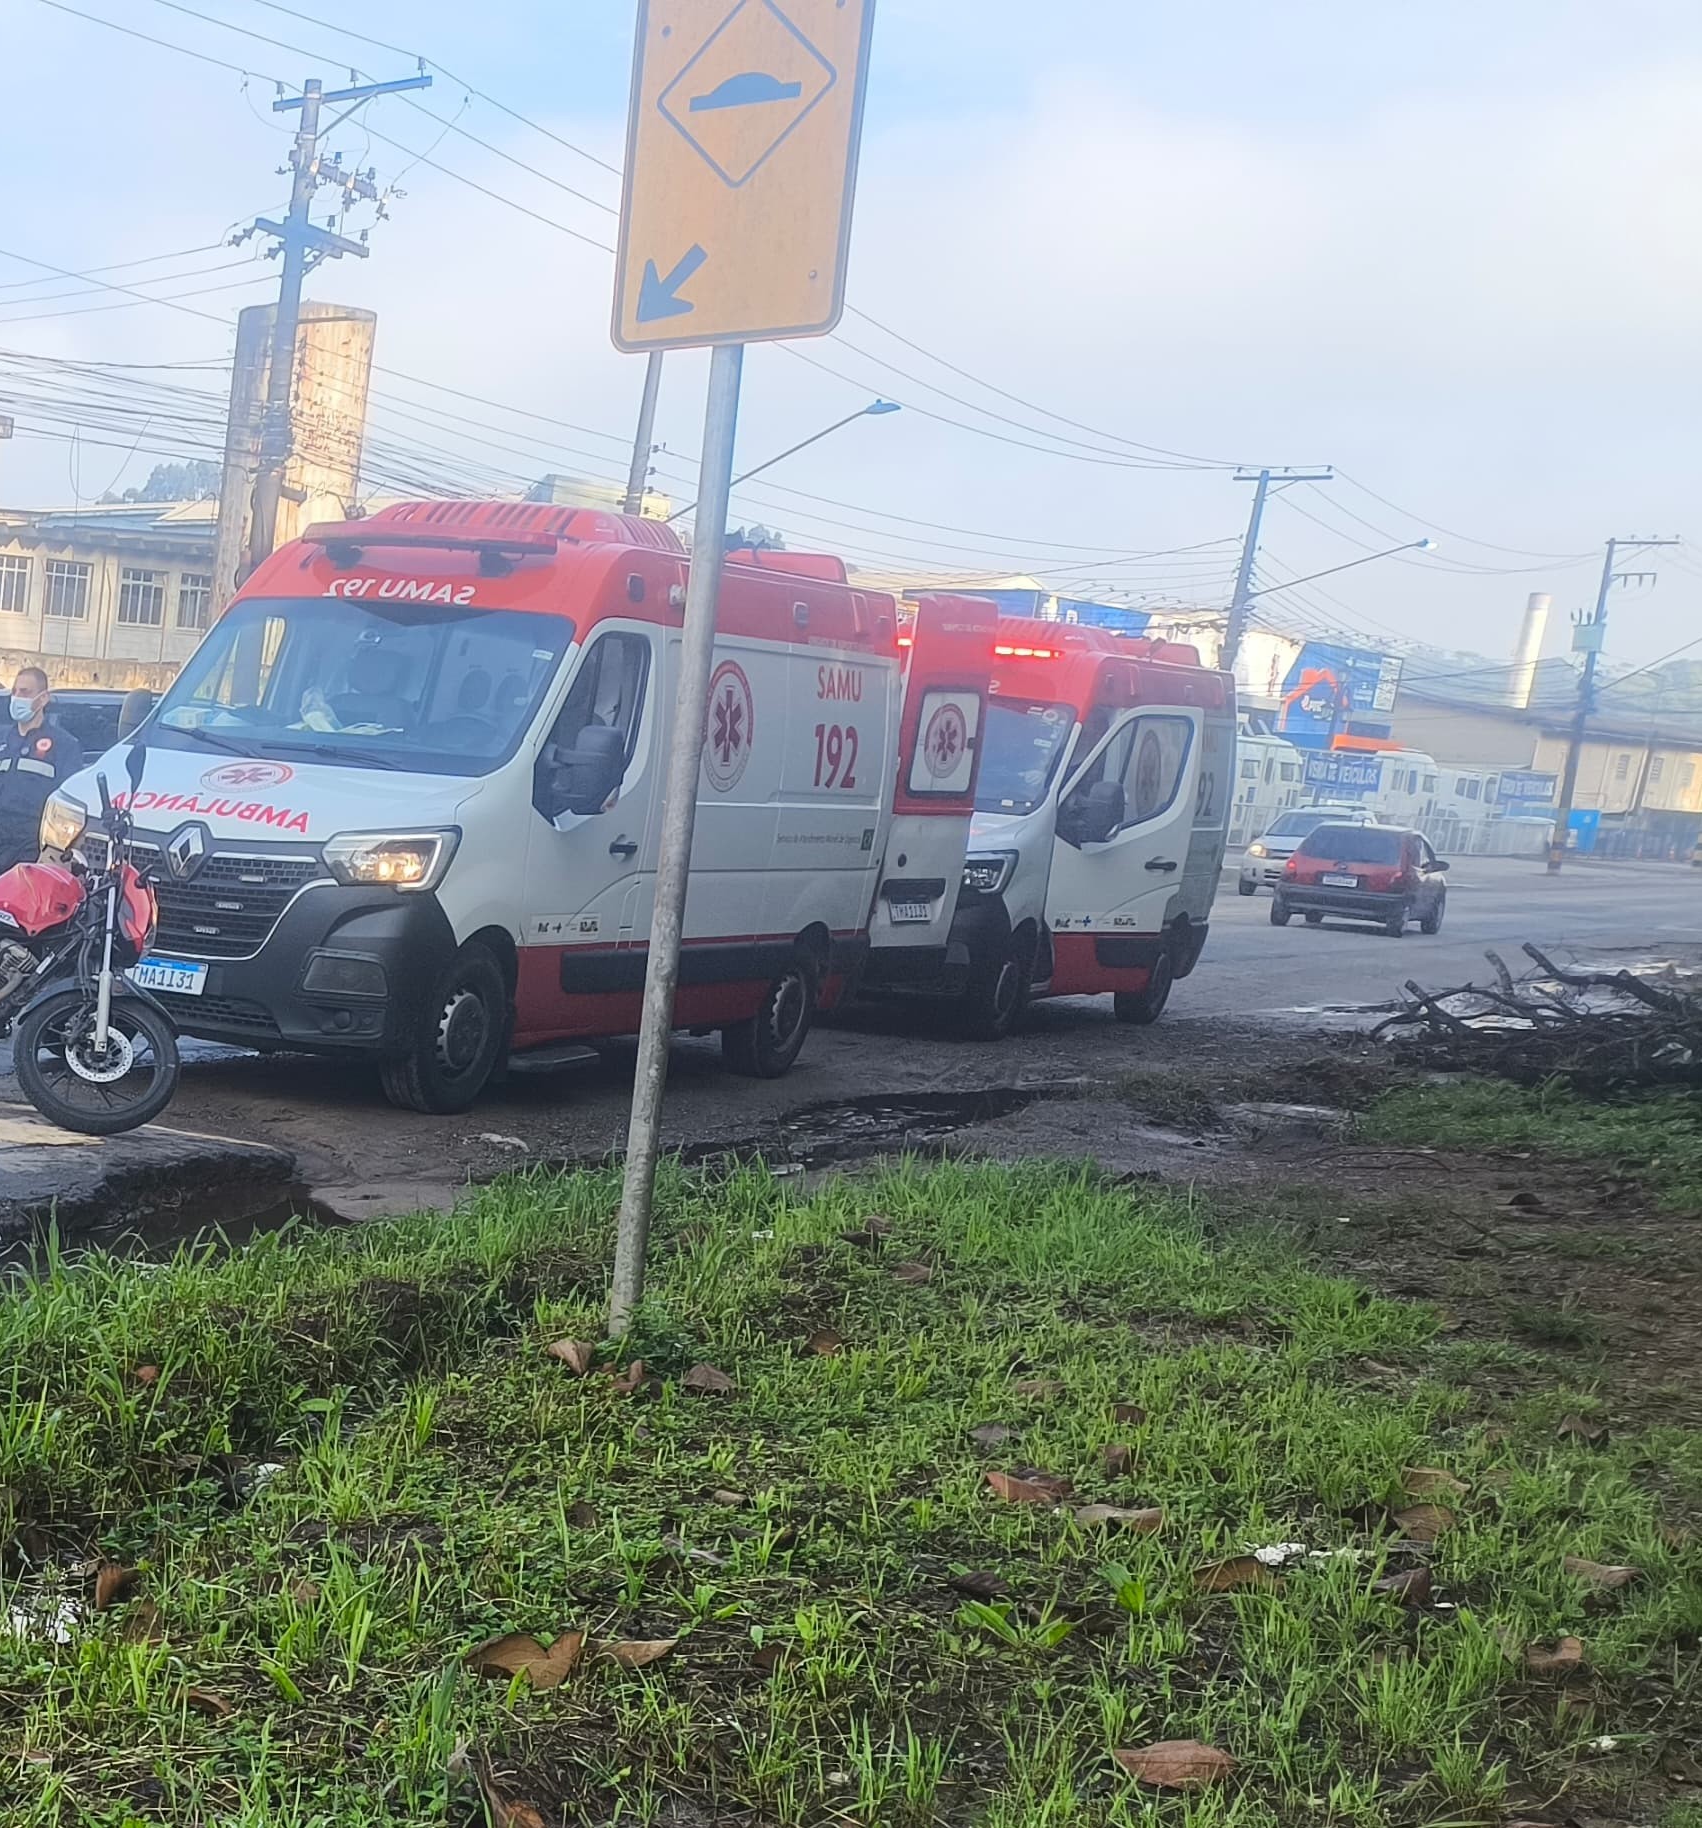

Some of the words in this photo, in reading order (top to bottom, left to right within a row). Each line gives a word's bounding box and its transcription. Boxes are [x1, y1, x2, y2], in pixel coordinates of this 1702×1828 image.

[817, 664, 863, 702] SAMU
[813, 722, 859, 789] 192
[1195, 771, 1215, 818] 92
